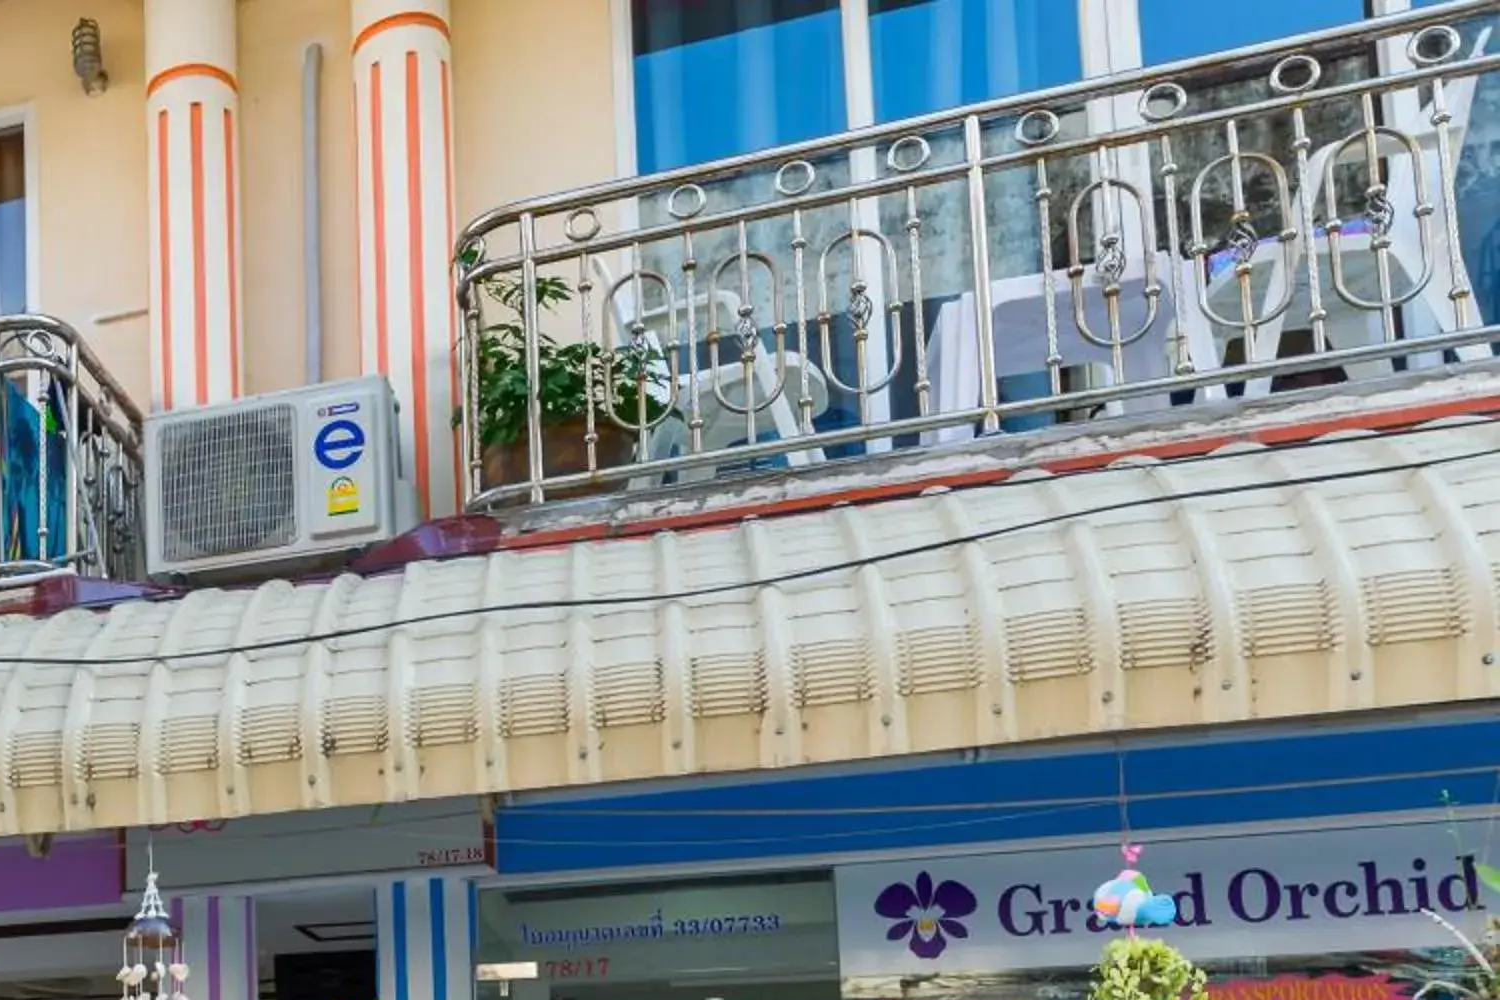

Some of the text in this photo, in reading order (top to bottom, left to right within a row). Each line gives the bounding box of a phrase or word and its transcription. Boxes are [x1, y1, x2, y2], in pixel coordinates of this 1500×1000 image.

[997, 854, 1487, 936] Grd Orchid
[545, 956, 611, 979] 78/17
